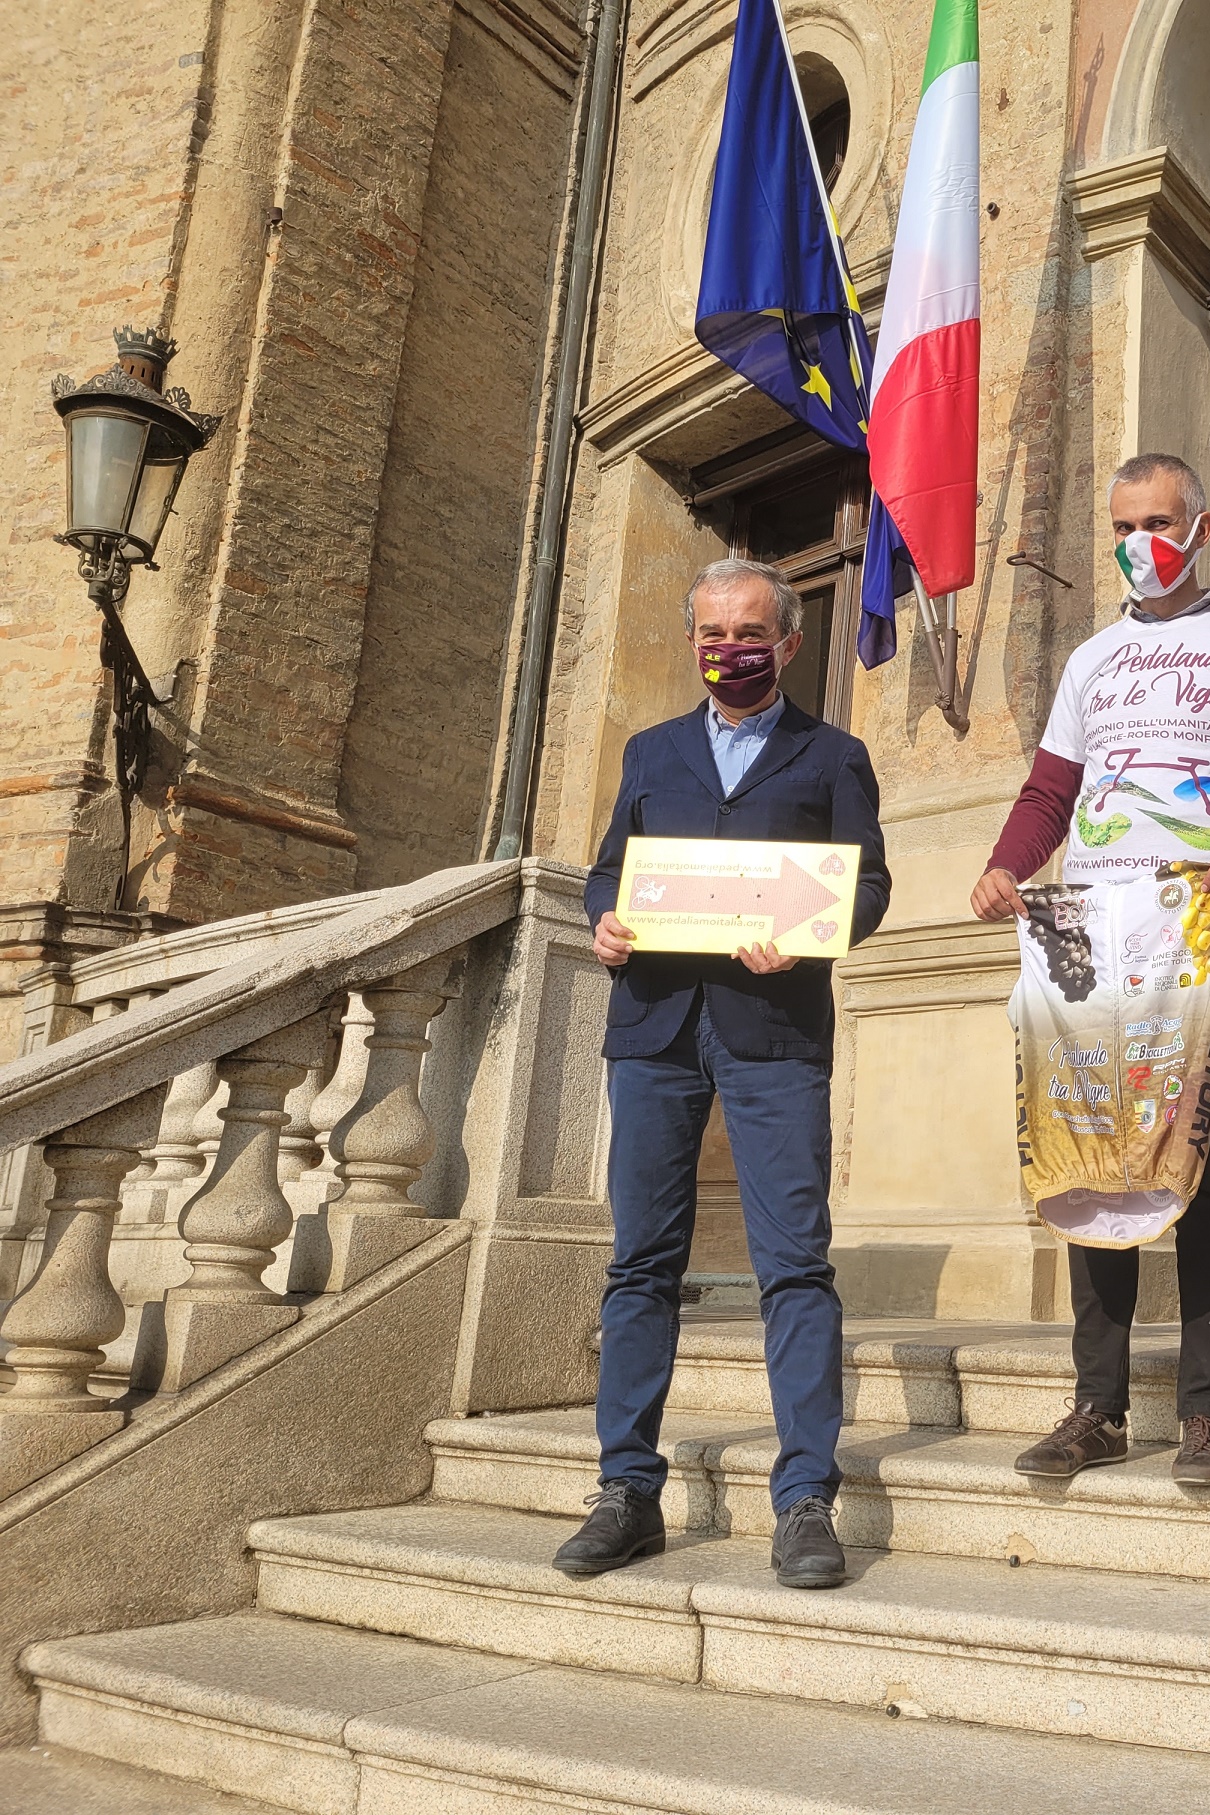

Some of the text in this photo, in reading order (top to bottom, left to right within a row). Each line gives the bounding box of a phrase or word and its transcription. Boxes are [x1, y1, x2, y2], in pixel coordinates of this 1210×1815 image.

[1087, 688, 1118, 718] tra
[1122, 679, 1147, 707] le
[1085, 721, 1125, 744] TRIMONIO
[634, 859, 773, 873] www.pedaliamoitalia.org
[626, 915, 766, 930] www.pedaliamoitalia.org
[1152, 949, 1192, 962] UNESCO
[1151, 958, 1192, 969] BIKE TOUR
[1048, 1074, 1069, 1099] tra
